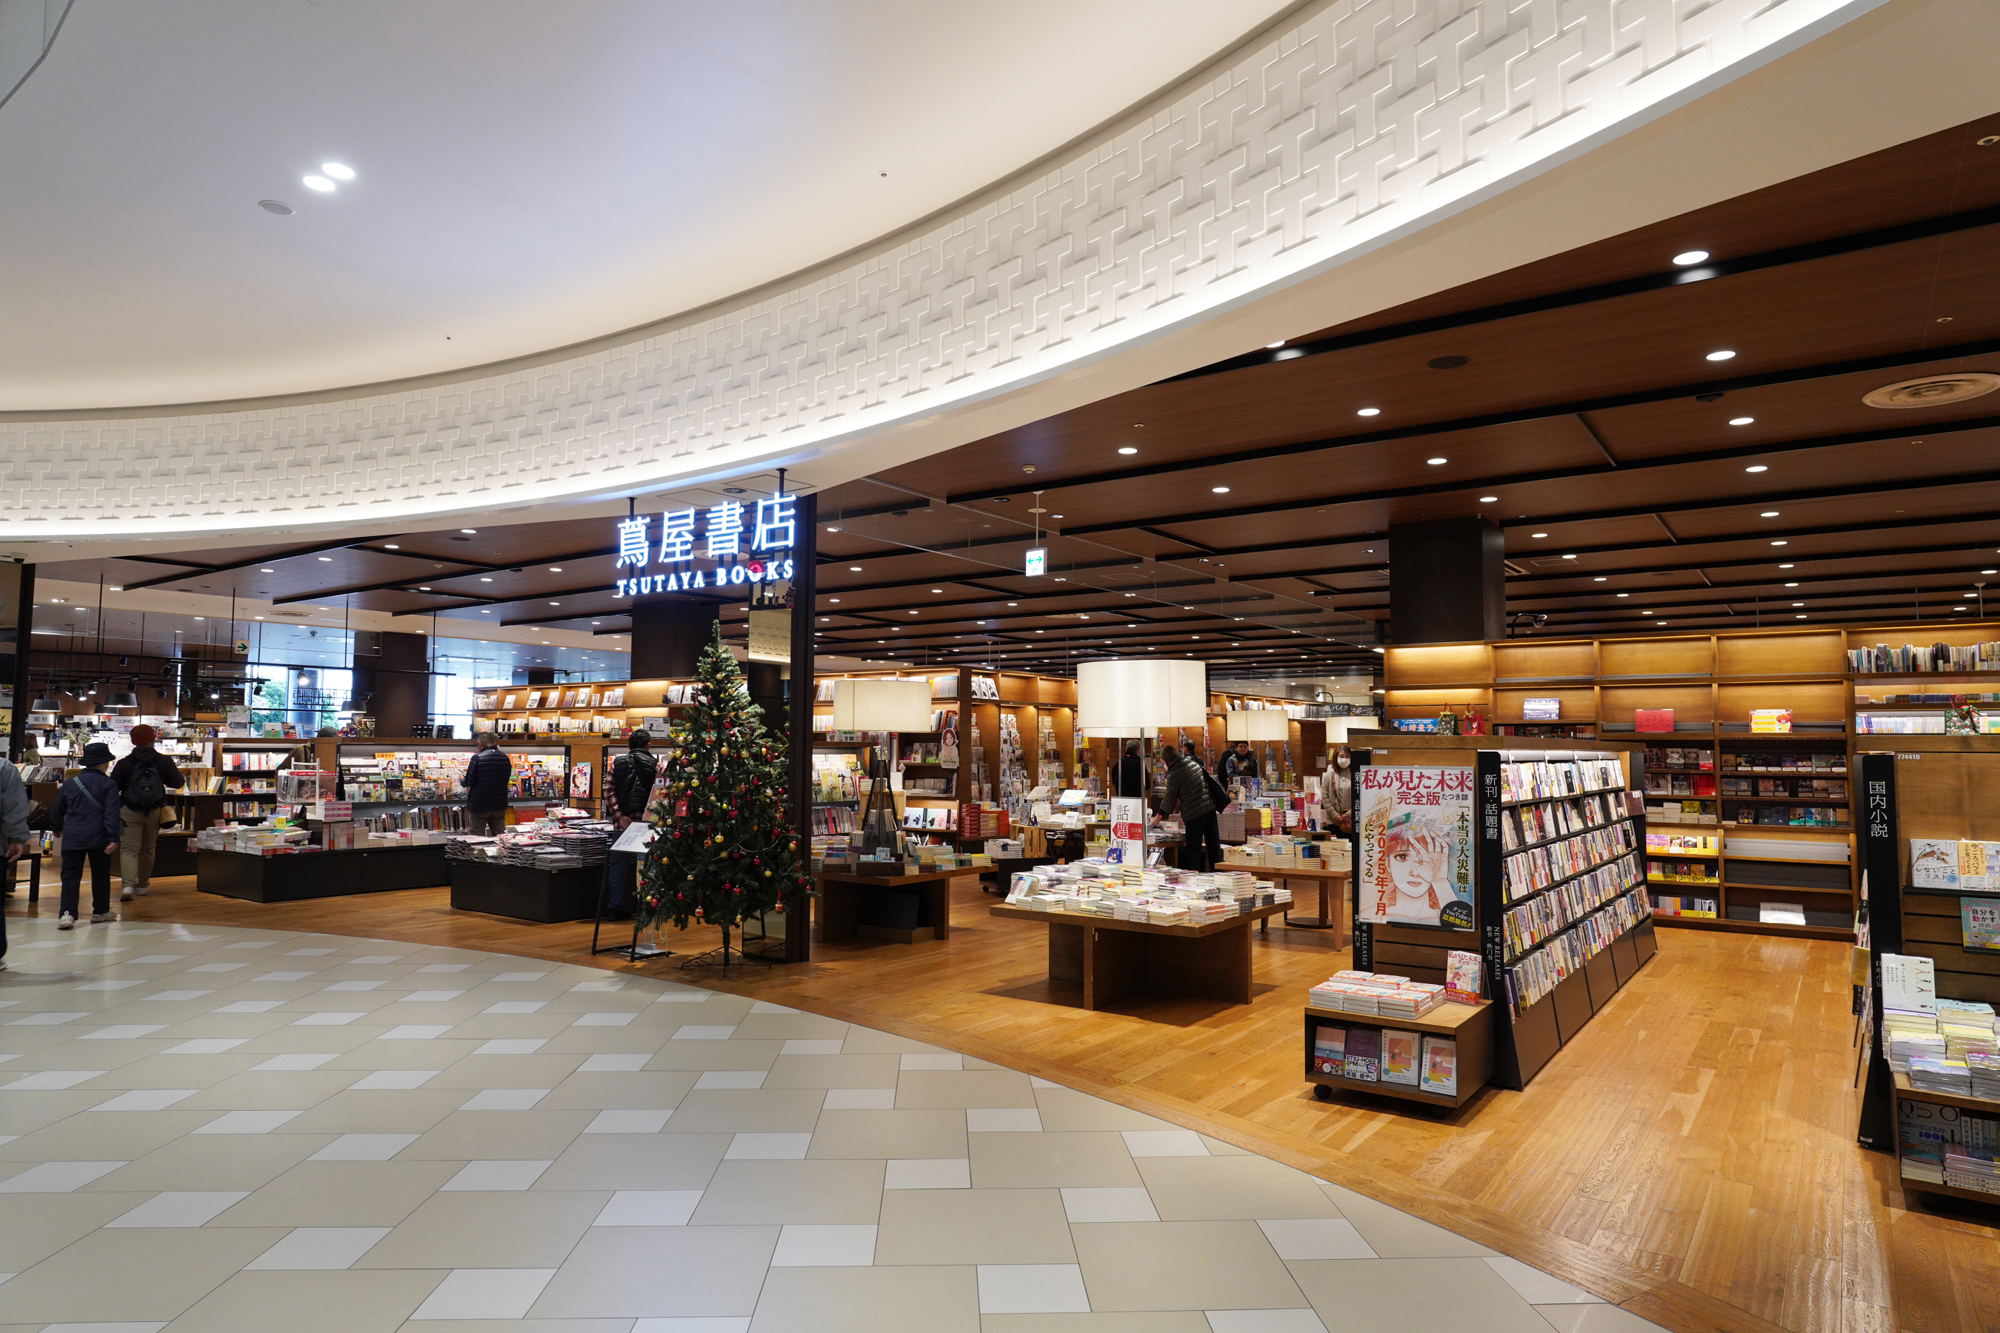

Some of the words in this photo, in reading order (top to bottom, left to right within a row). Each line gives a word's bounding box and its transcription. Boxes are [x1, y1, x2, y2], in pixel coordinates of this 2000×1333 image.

[616, 491, 797, 569] 蔦屋書店
[616, 570, 705, 597] TSUTAYA
[1361, 769, 1473, 792] 私が見た未来
[1397, 791, 1441, 806] 完全版
[1484, 773, 1498, 840] 新刊・話題書
[1869, 781, 1888, 838] 国内小説
[1375, 825, 1388, 916] 2025年7月
[1916, 866, 1957, 875] しないこと
[1972, 908, 1996, 916] 自分を
[1972, 915, 1997, 923] 動かす
[1494, 945, 1502, 980] RELEASES
[1918, 1131, 1946, 1141] 1001
